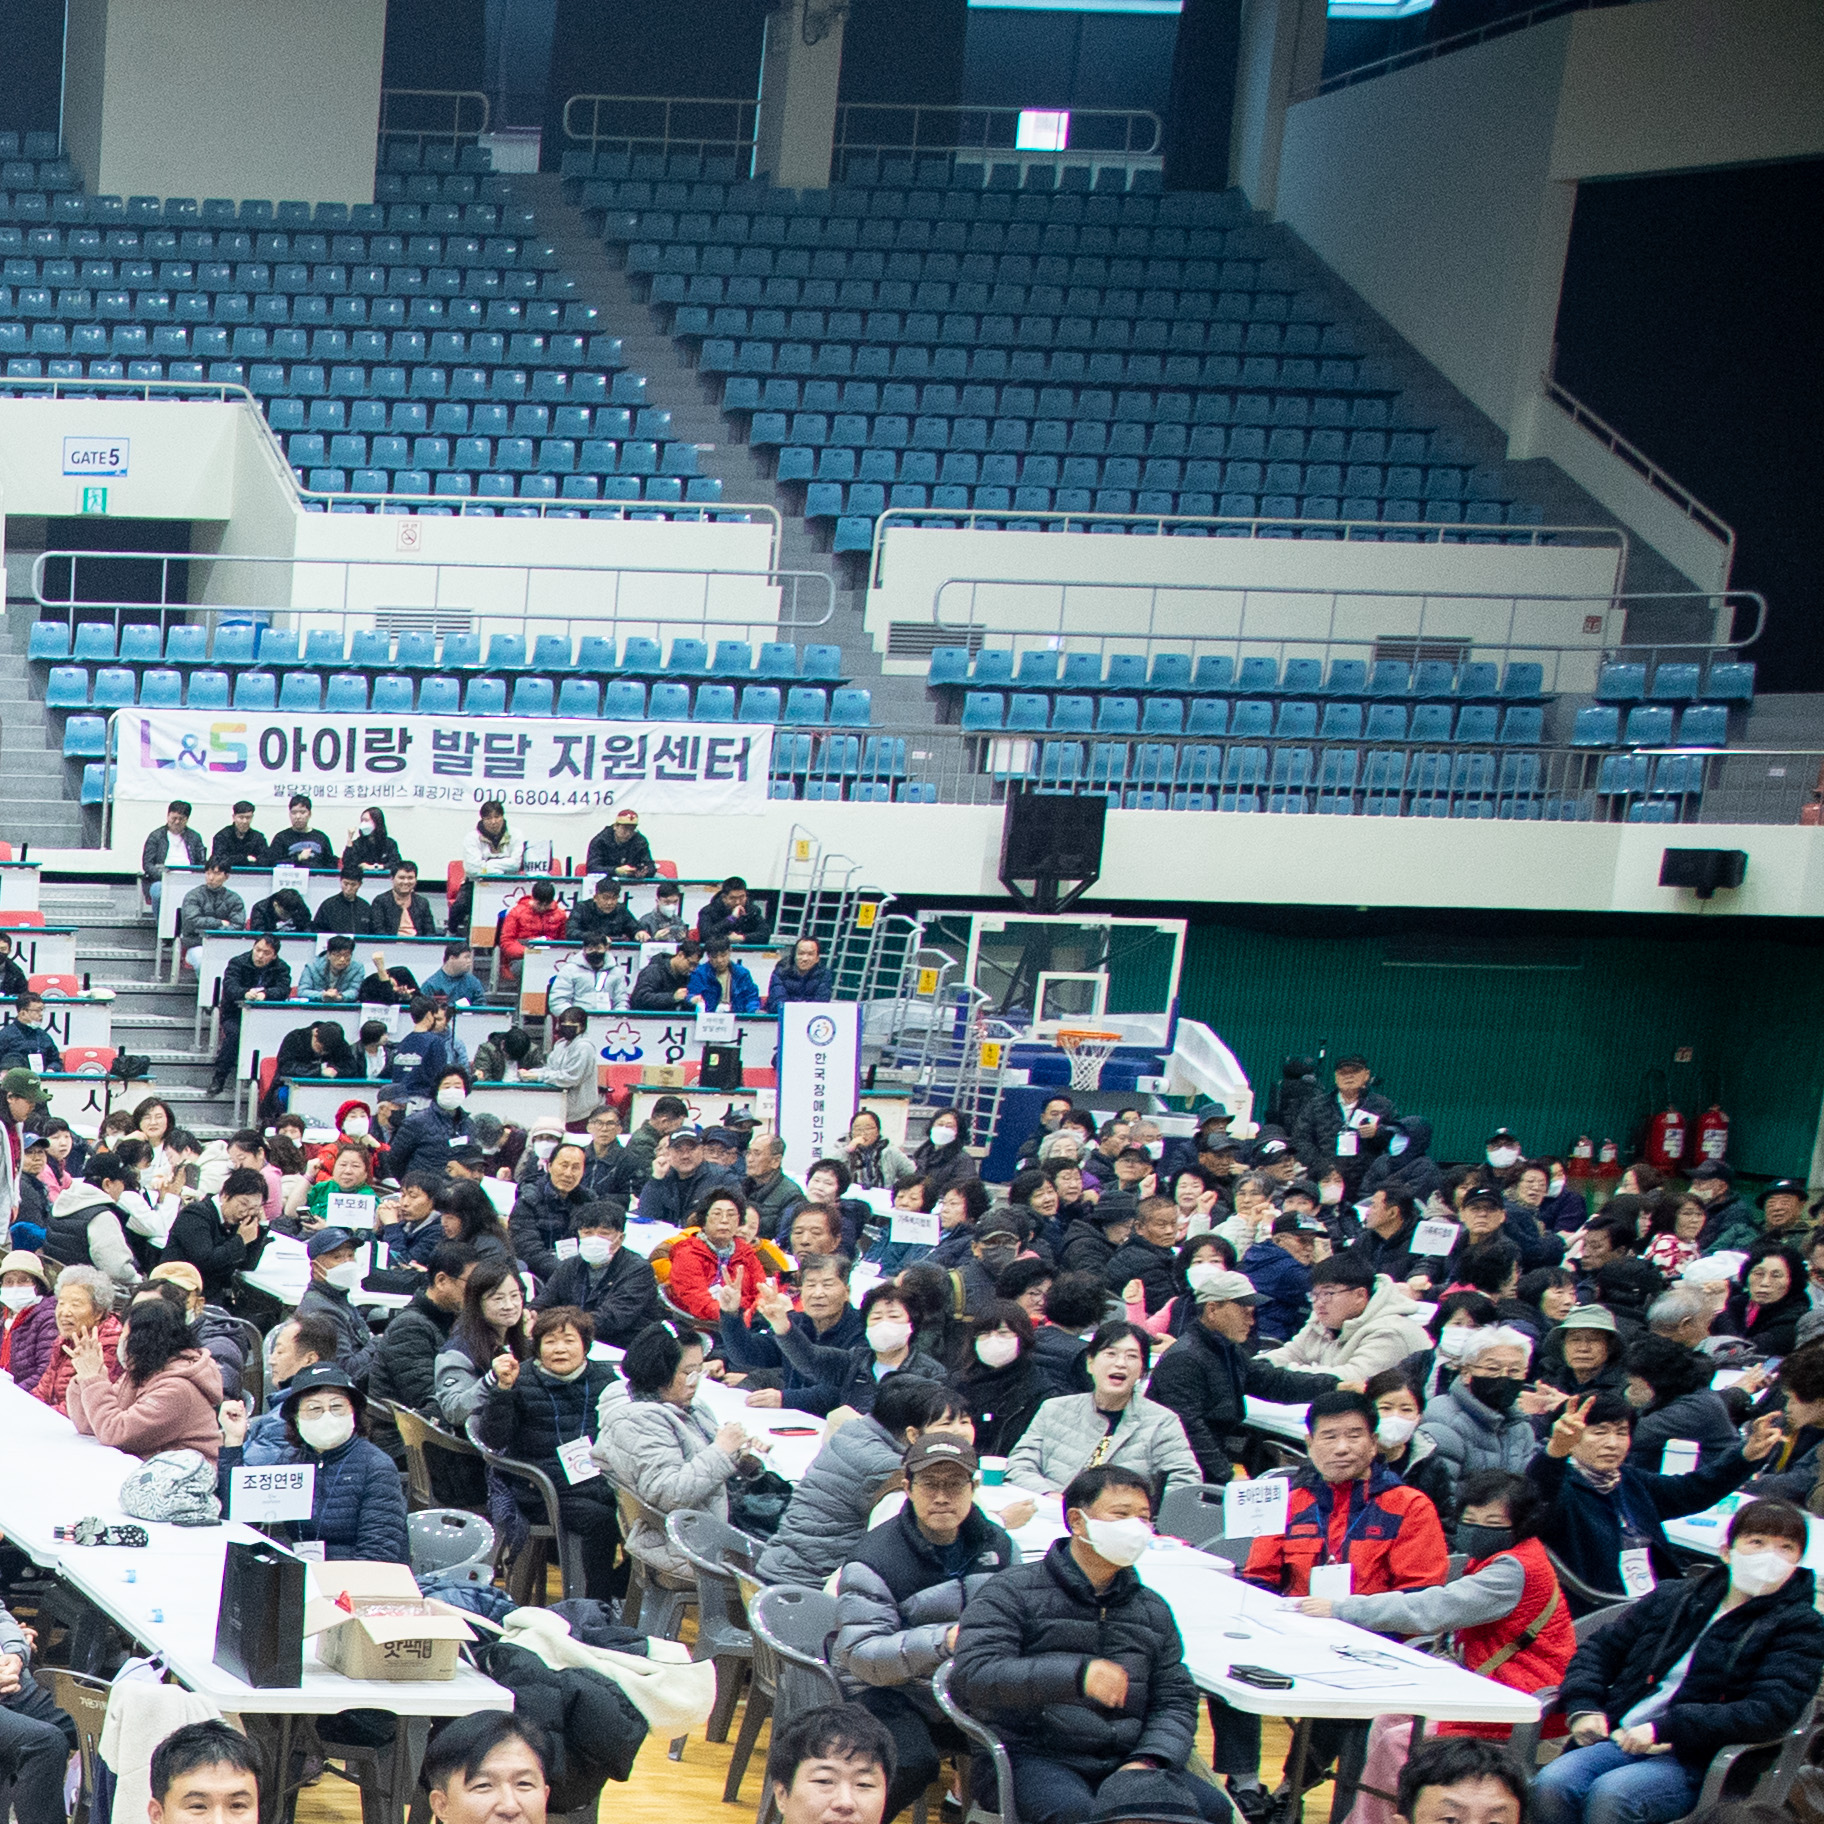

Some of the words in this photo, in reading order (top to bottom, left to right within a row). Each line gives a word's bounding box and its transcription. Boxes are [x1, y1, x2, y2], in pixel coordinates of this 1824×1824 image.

[139, 719, 248, 773] L&S
[259, 725, 412, 774] 아이랑
[432, 730, 532, 780] 발달
[548, 735, 751, 784] 지원센터
[273, 783, 338, 799] 발달장애인
[343, 784, 408, 799] 종합서비스
[413, 786, 464, 802] 제공기관
[473, 786, 615, 807] 010.6804.4416
[334, 1198, 368, 1210] 부모회
[242, 1472, 304, 1491] 조정연맹
